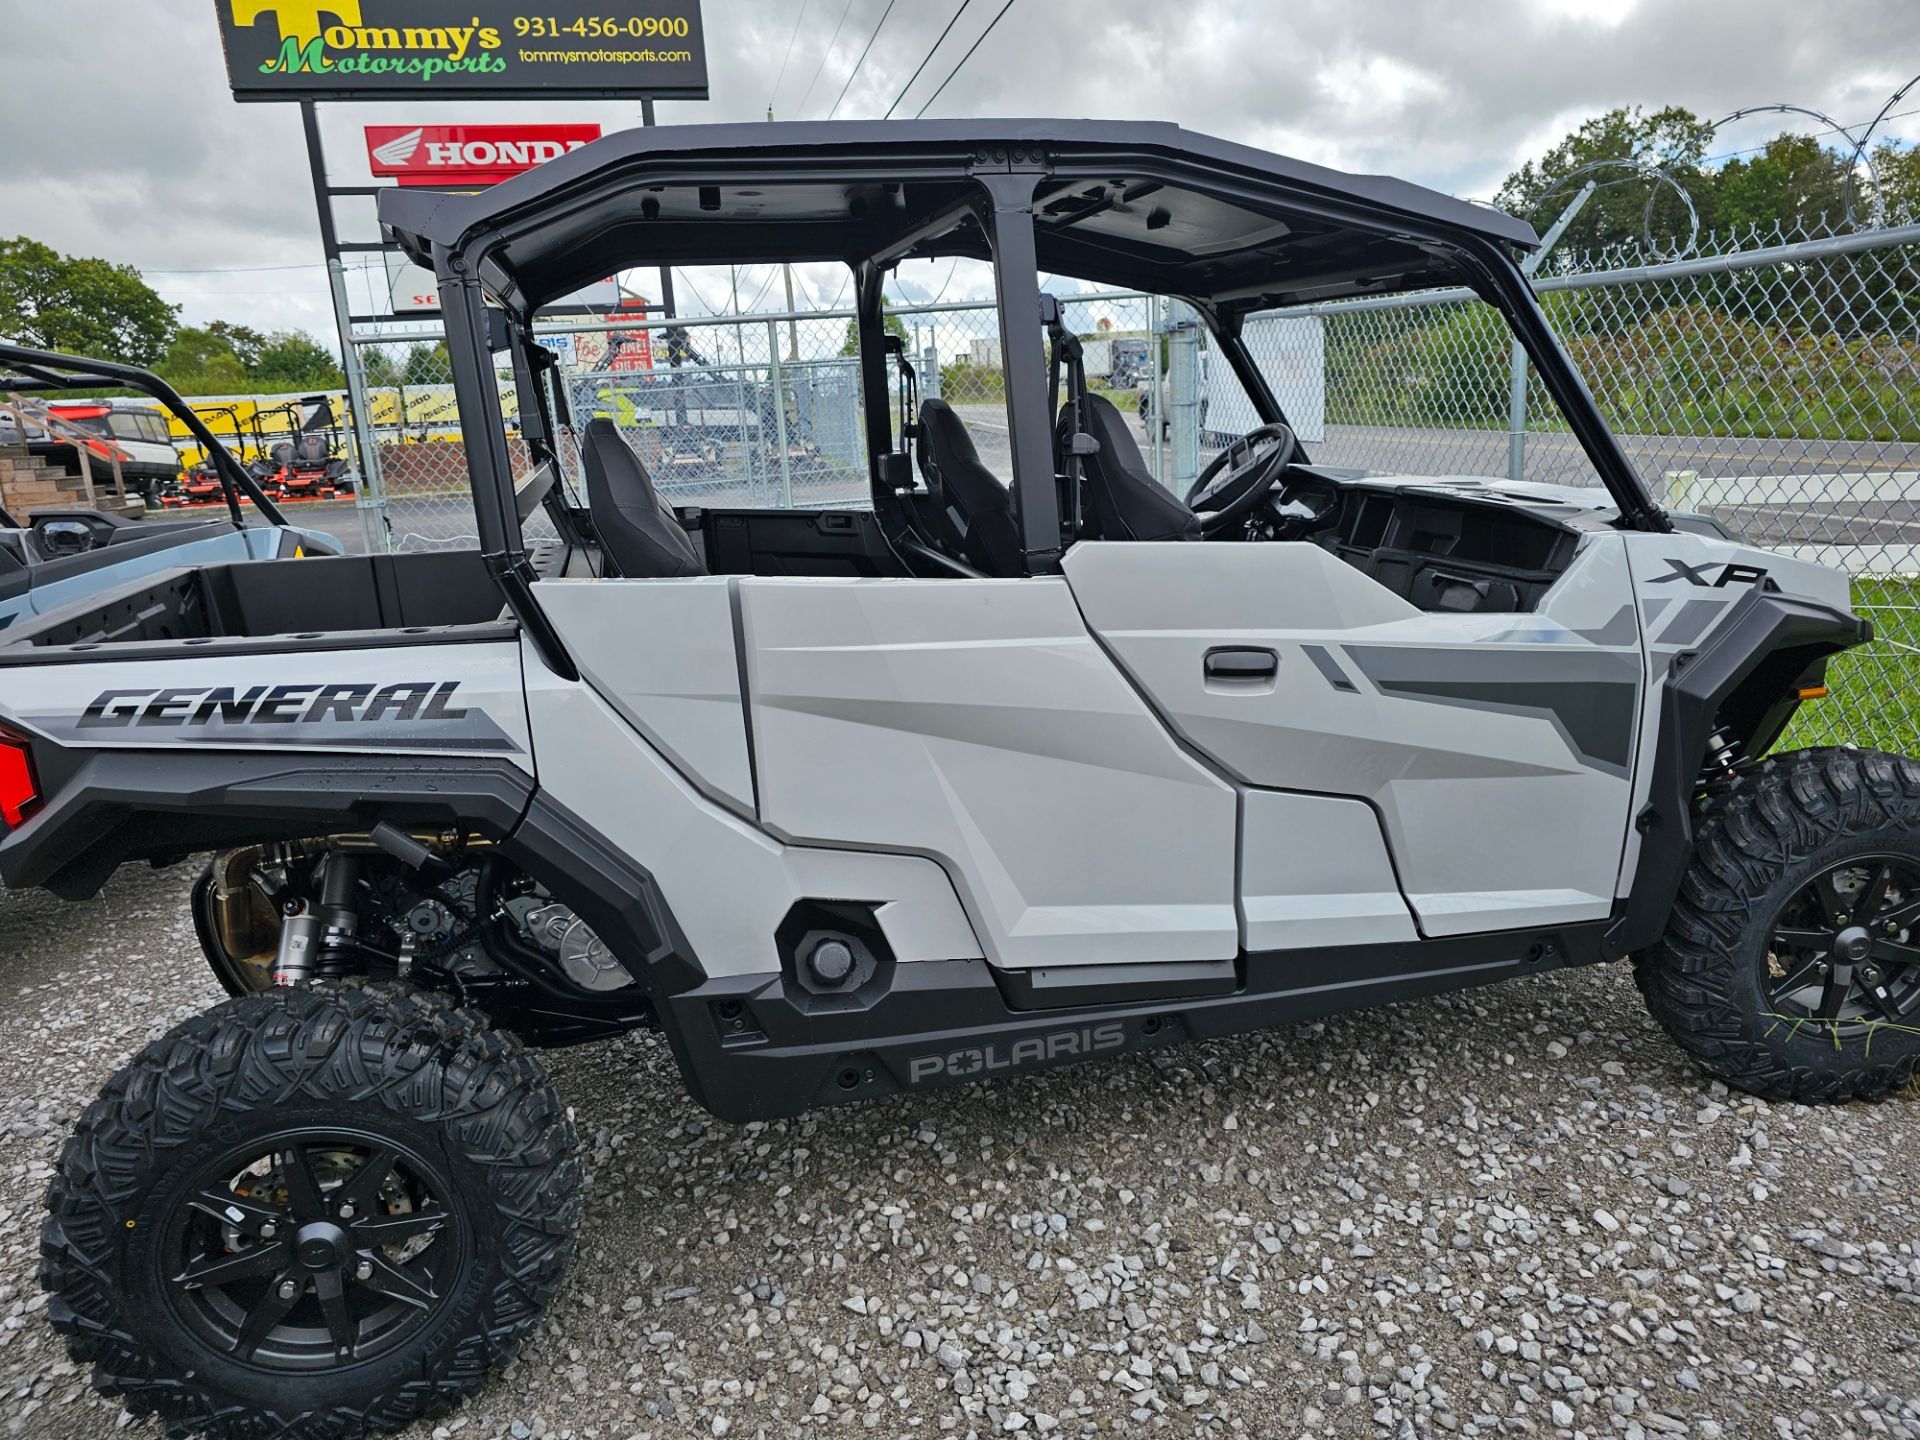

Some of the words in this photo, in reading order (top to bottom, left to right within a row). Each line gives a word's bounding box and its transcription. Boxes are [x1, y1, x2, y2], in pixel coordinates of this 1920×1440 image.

[231, 0, 502, 62] Tommy's
[513, 16, 689, 37] 931-456-0900
[258, 36, 507, 81] Motorsports
[518, 48, 691, 64] tommysmotorsports.com
[75, 681, 470, 728] GENERAL
[910, 1023, 1125, 1083] POLARIS
